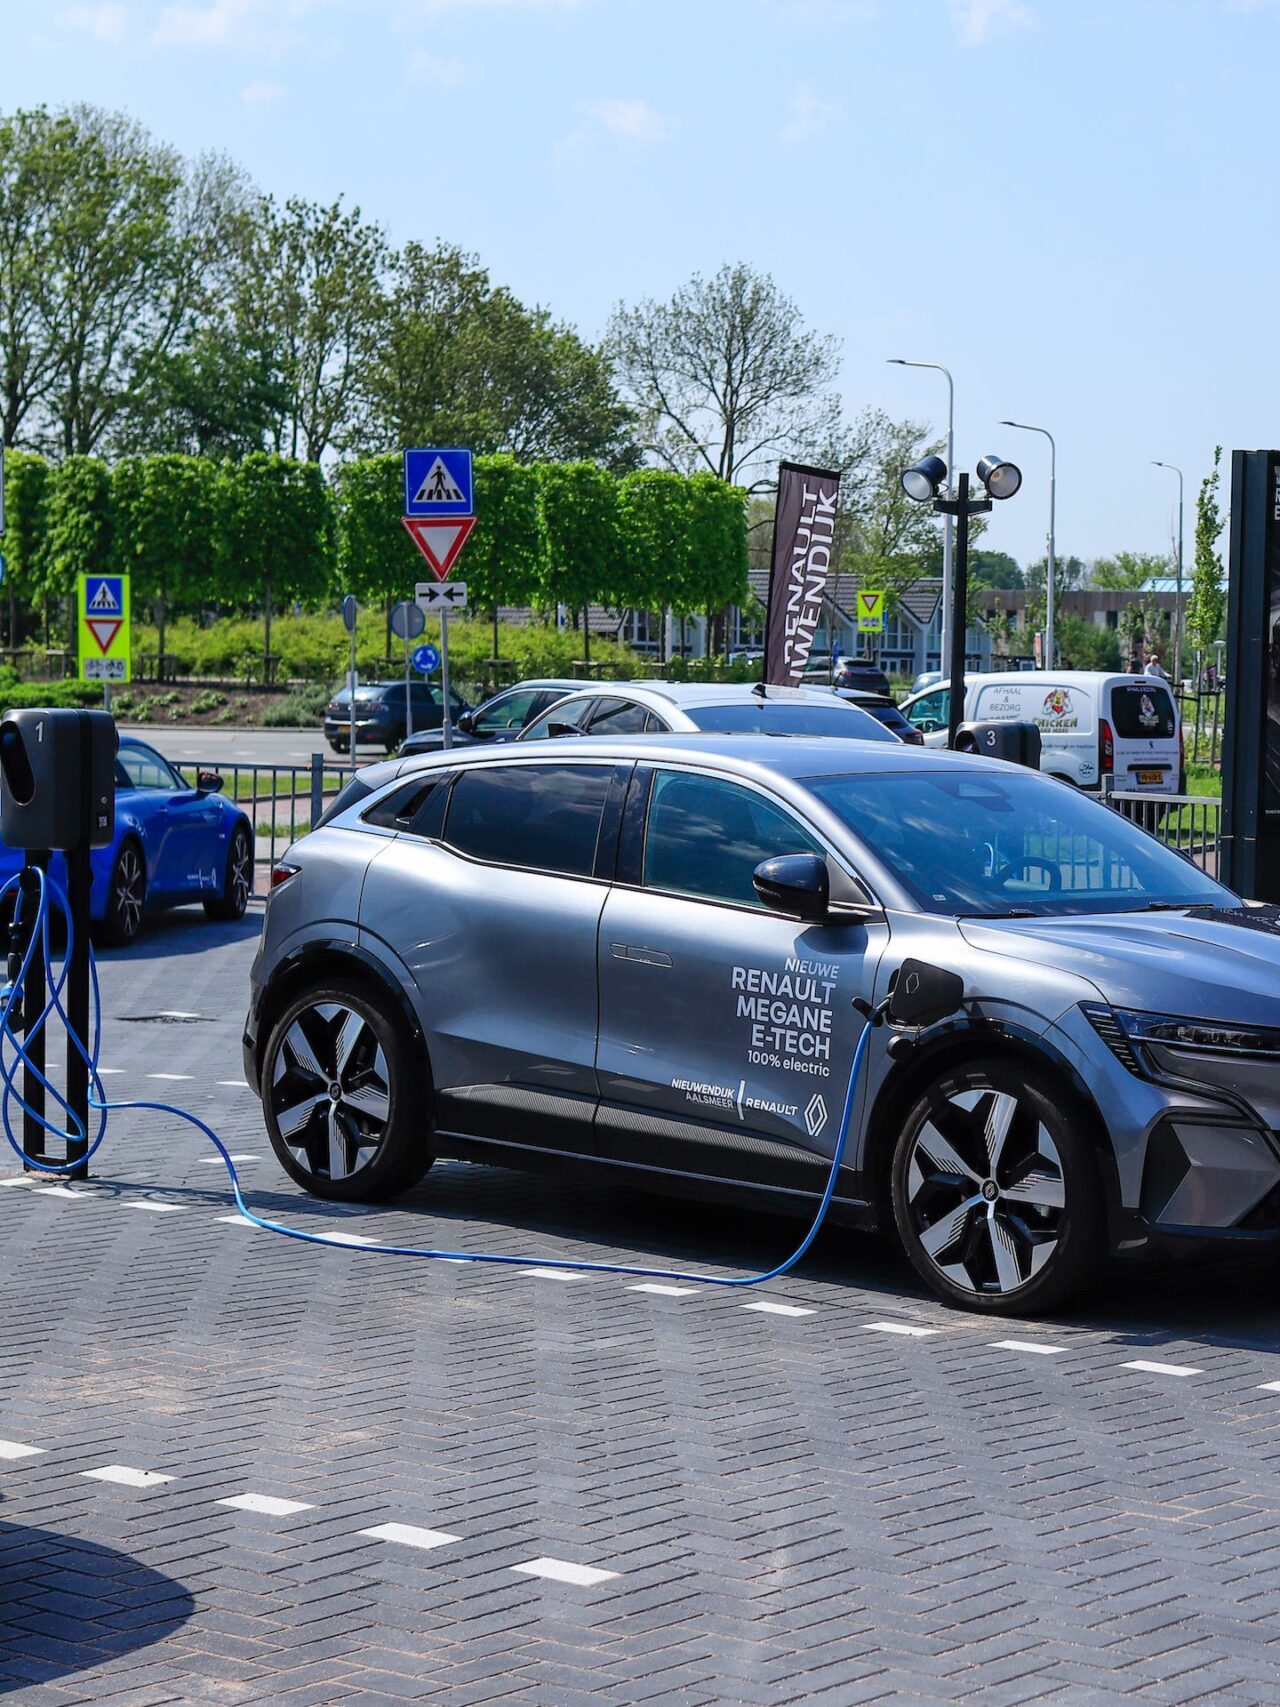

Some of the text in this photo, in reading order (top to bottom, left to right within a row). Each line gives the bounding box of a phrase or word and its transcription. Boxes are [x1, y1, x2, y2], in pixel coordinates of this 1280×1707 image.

[994, 687, 1022, 695] AFHAAL
[989, 703, 1021, 712] BEZORG
[36, 721, 44, 742] 1
[986, 730, 996, 746] 3
[784, 958, 840, 979] NIEUWE
[731, 966, 837, 1005] RENAULT
[736, 995, 833, 1034] MEGANE
[751, 1023, 831, 1060] E-TECH
[747, 1050, 830, 1077] 100% electric
[671, 1078, 735, 1099] NIEUWENDIJK
[686, 1091, 734, 1109] AALSMEER
[745, 1097, 799, 1116] RENAULT
